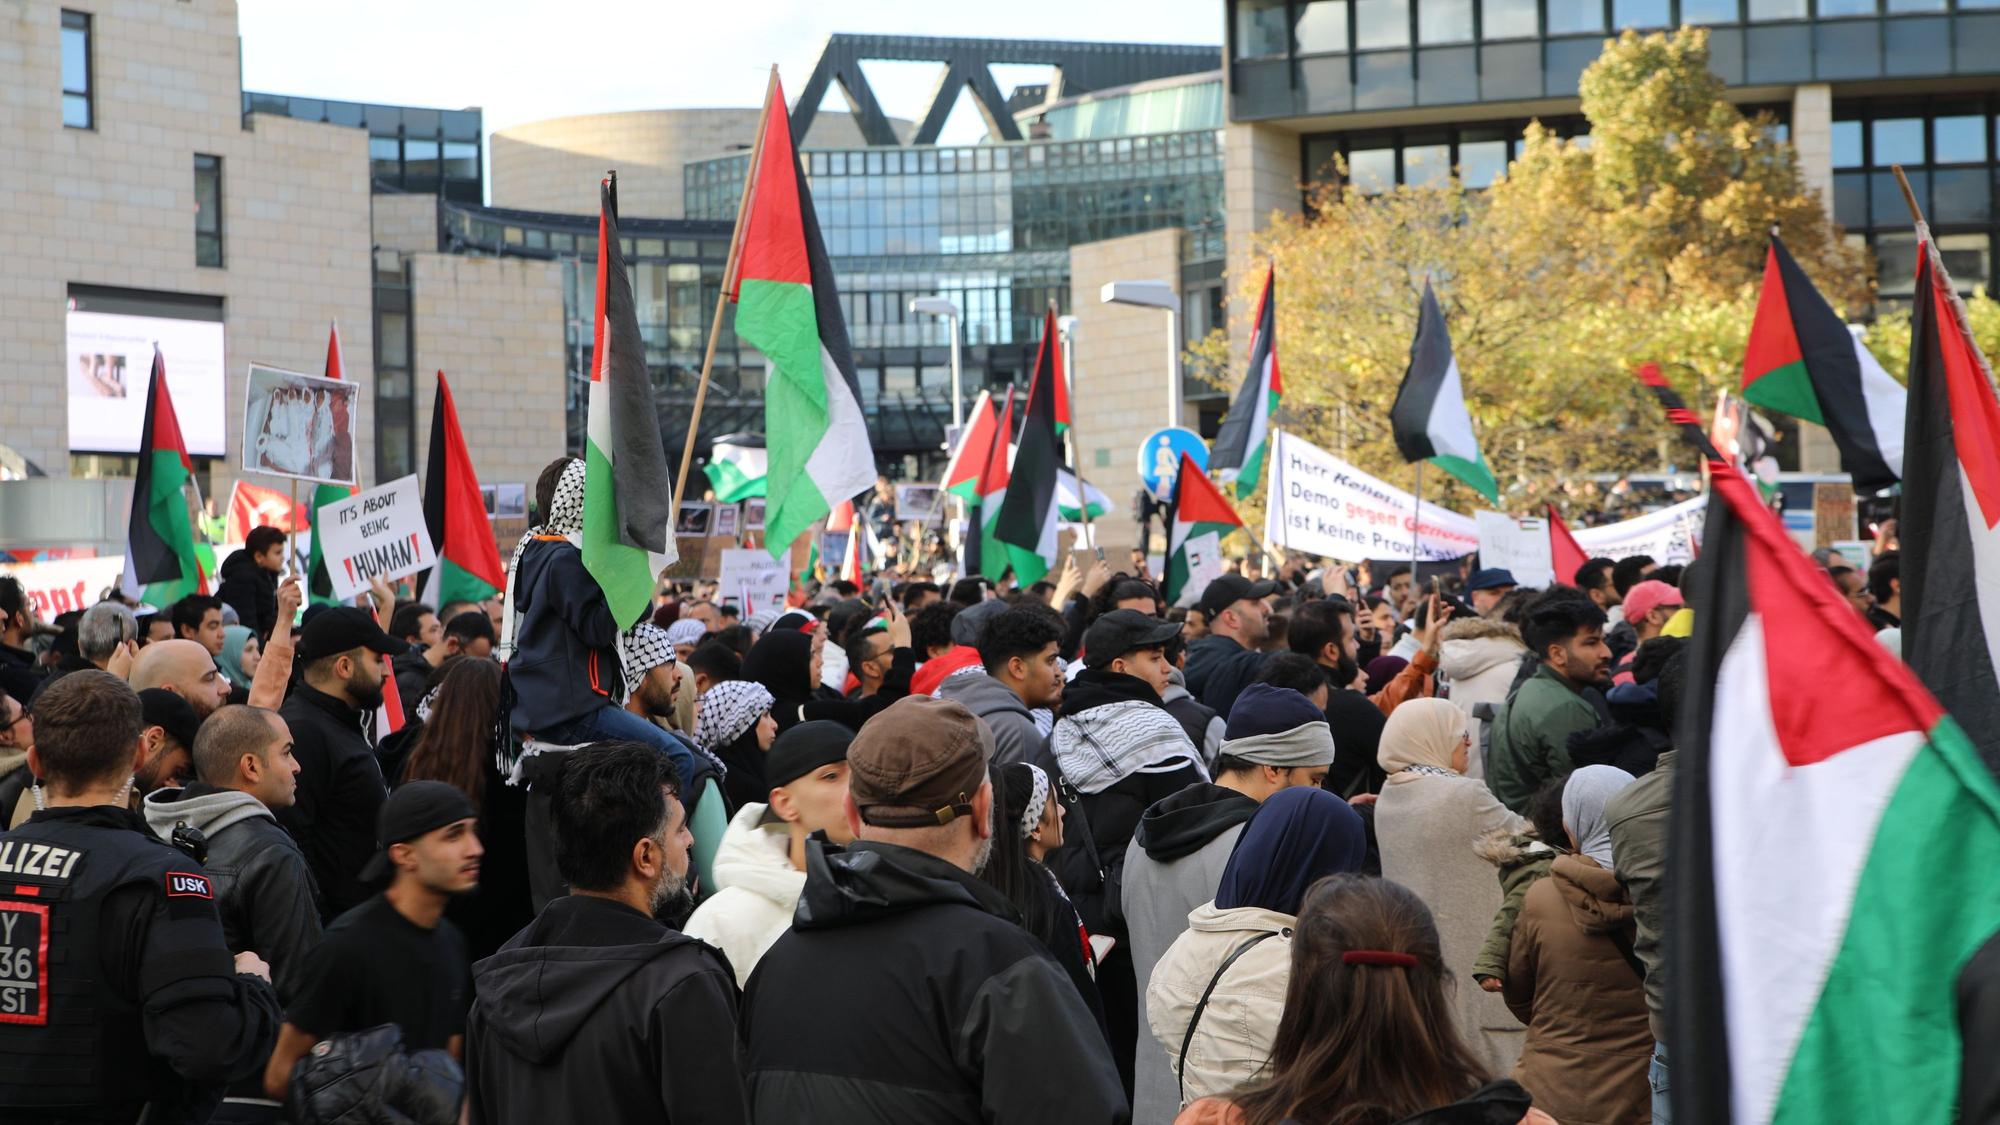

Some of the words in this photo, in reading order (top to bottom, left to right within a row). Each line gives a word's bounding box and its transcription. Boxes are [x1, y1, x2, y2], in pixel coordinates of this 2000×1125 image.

[1291, 453, 1327, 478] Herr
[339, 504, 358, 525] IT'S
[363, 491, 397, 515] ABOUT
[1291, 481, 1340, 510] Demo
[1346, 501, 1397, 526] gegen
[360, 516, 390, 538] BEING
[1288, 508, 1310, 531] ist
[1318, 517, 1366, 544] keine
[0, 840, 81, 878] LIZEI
[173, 876, 207, 893] USK
[0, 946, 33, 980] 36
[1, 987, 26, 1013] Si
